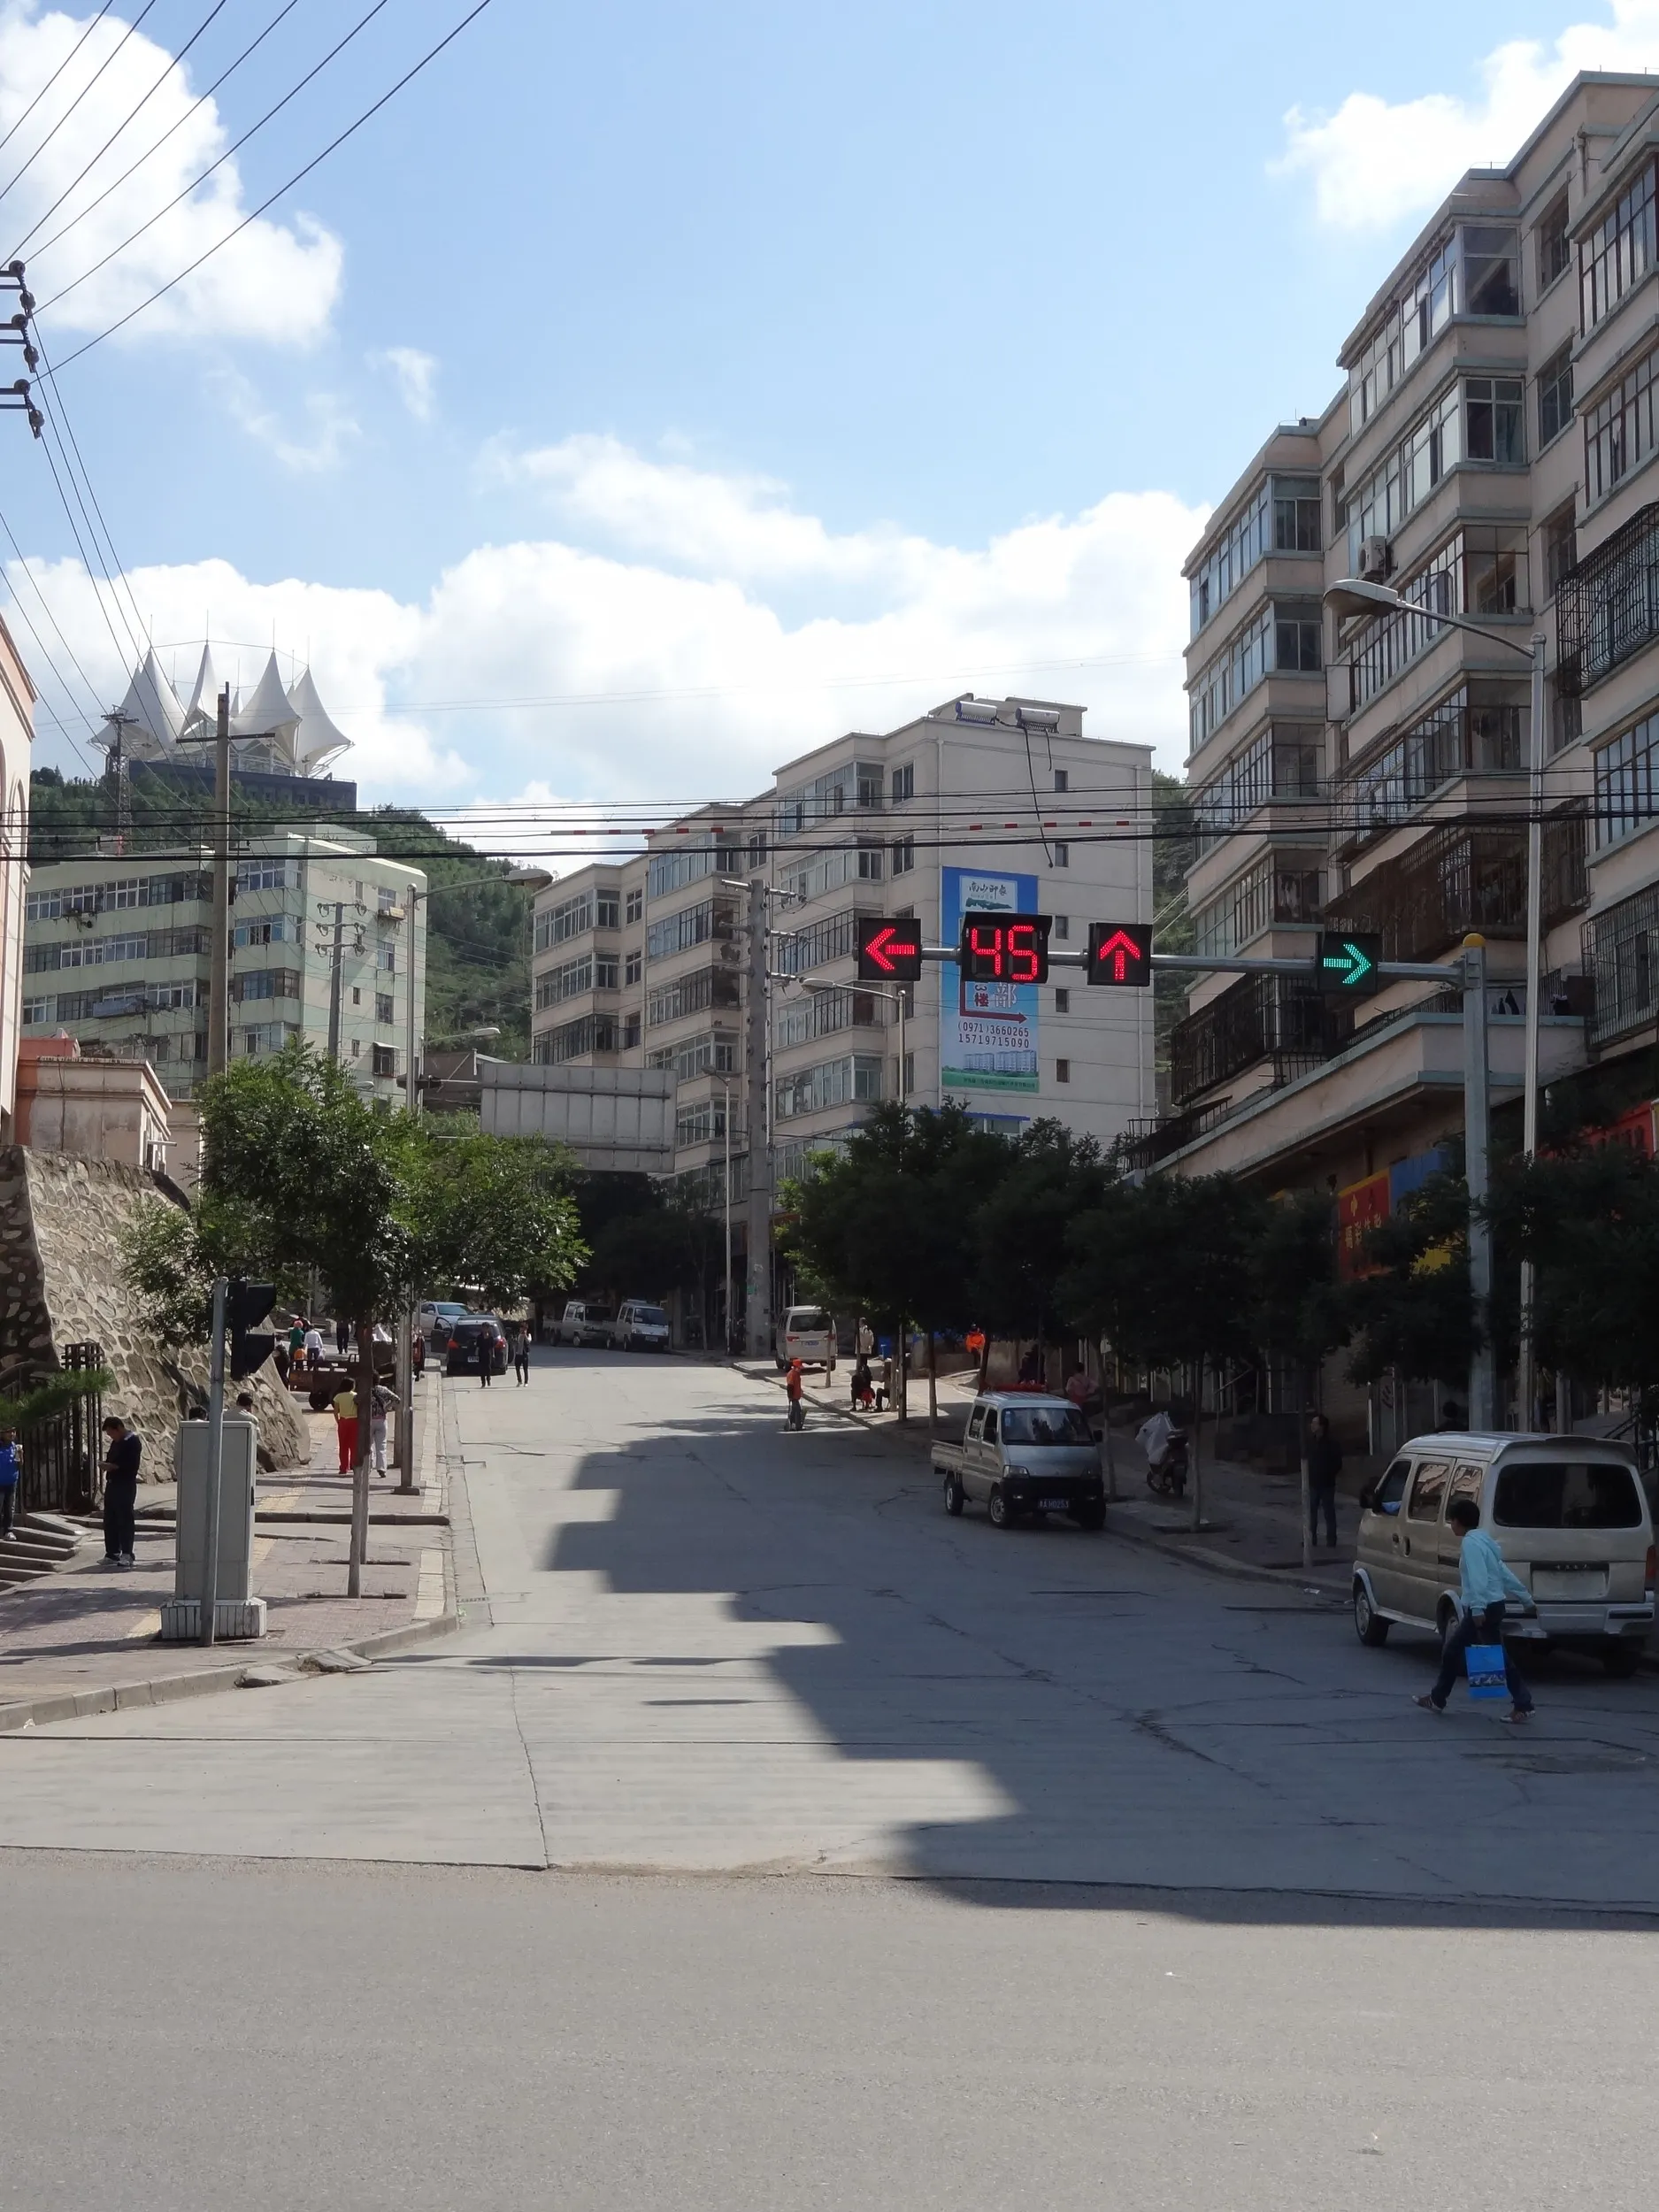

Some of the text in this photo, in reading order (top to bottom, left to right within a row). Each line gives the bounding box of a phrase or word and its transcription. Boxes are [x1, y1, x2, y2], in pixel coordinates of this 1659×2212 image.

[971, 925, 1038, 980] 45
[958, 1020, 1029, 1037] (0971)3660265
[958, 1033, 1029, 1048] 15719715090
